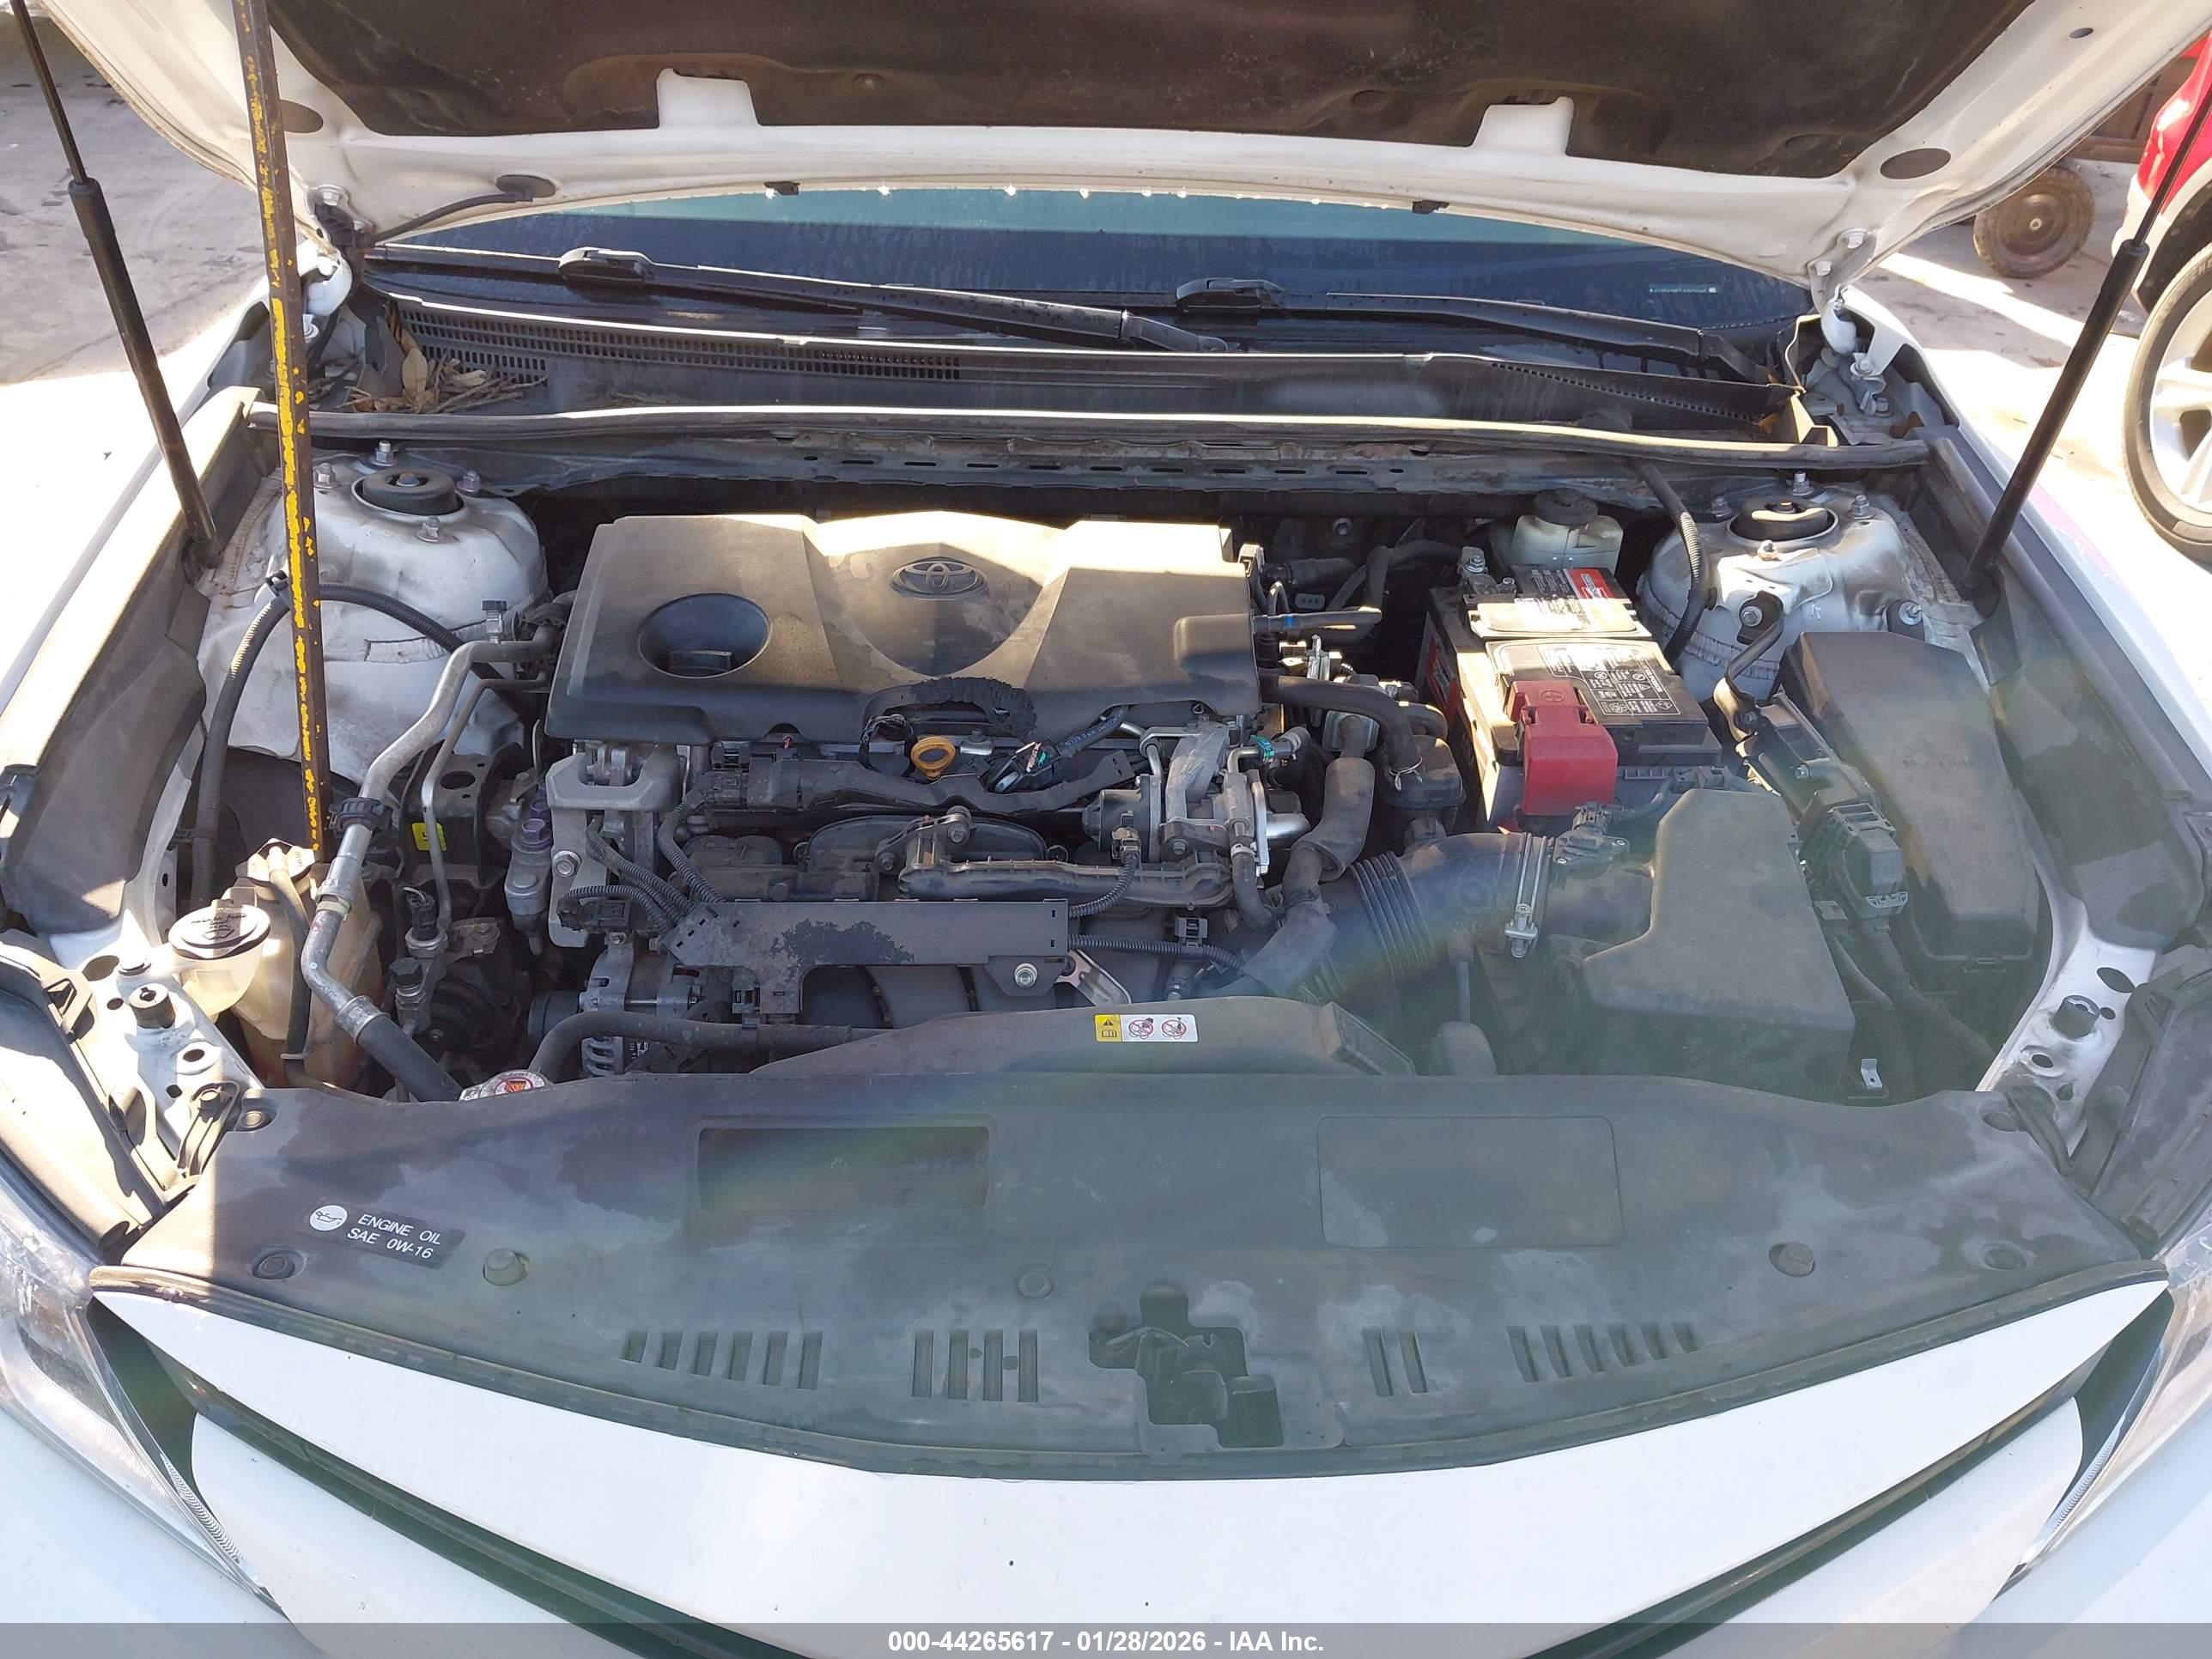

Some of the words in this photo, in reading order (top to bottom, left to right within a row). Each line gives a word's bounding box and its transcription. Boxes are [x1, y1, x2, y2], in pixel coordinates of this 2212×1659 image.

[347, 1227, 381, 1244] SAE
[386, 1238, 434, 1259] 0W-16
[357, 1213, 414, 1237] ENGINE
[419, 1230, 441, 1245] OIL
